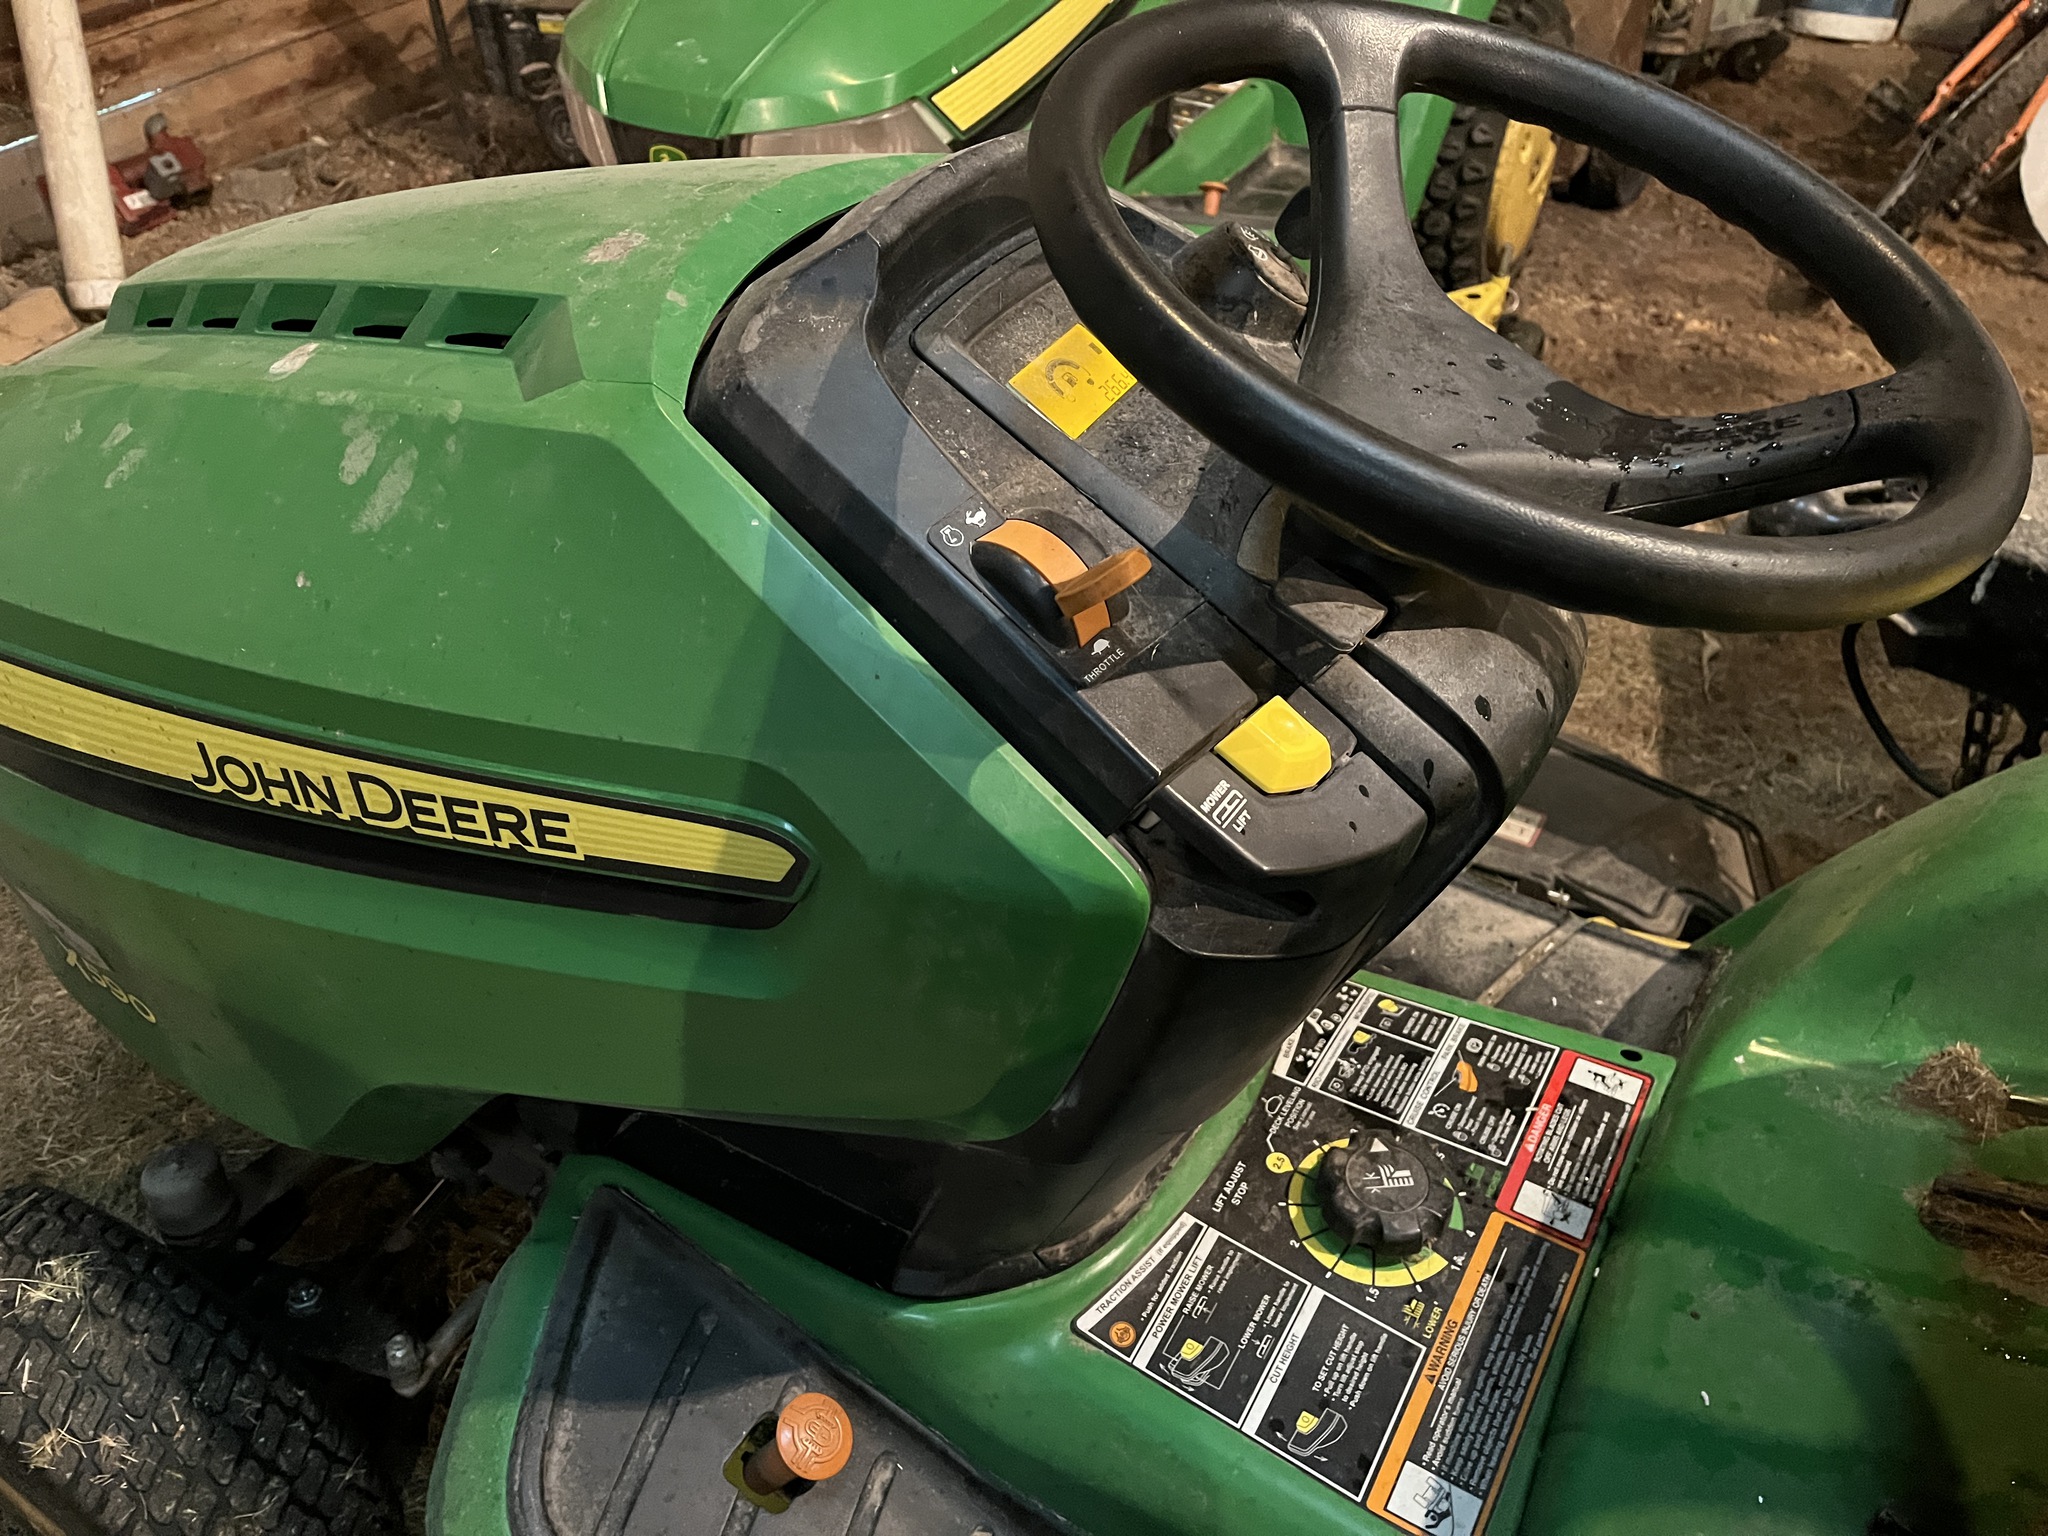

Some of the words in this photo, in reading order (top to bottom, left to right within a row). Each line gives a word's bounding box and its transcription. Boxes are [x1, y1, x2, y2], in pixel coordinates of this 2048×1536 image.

[1098, 369, 1134, 402] 266.4
[1083, 647, 1125, 683] THROTTLE
[191, 741, 344, 815] JOHN
[347, 771, 578, 854] DEERE
[1200, 779, 1231, 814] MOWER
[1232, 809, 1251, 833] LIFT
[1269, 1115, 1284, 1134] DECK
[1280, 1086, 1301, 1116] LEVELING
[1284, 1099, 1305, 1127] POSITION
[1407, 1101, 1423, 1125] CRUISE
[1420, 1072, 1440, 1099] CONTROL
[1528, 1104, 1551, 1143] DANGER
[1273, 1156, 1285, 1170] 2.5
[1213, 1193, 1227, 1212] LIFT
[1223, 1161, 1246, 1194] ADJUST
[1231, 1182, 1248, 1205] STOP
[1290, 1240, 1300, 1248] 2
[1465, 1229, 1476, 1238] 4
[1096, 1279, 1132, 1313] TRACTION
[1131, 1256, 1155, 1281] ASSIST
[1152, 1307, 1174, 1338] POWER
[1170, 1274, 1192, 1306] MOWER
[1188, 1255, 1202, 1273] LIFT
[1182, 1291, 1199, 1314] RAISE
[1195, 1265, 1214, 1291] MOWER
[1365, 1285, 1381, 1303] 1.5
[1141, 1302, 1154, 1318] Push
[1151, 1292, 1159, 1302] for
[1238, 1321, 1256, 1349] LOWER
[1253, 1295, 1270, 1321] MOWER
[1422, 1307, 1443, 1339] LOWER
[1428, 1319, 1458, 1371] WARNING
[1438, 1367, 1452, 1391] AVOID
[1447, 1335, 1467, 1367] SERIOUS
[1461, 1308, 1476, 1335] INJURY
[1472, 1297, 1482, 1308] OR
[1477, 1274, 1491, 1297] DEATH
[1269, 1365, 1283, 1383] CUT
[1279, 1333, 1299, 1365] HEIGHT
[1312, 1381, 1322, 1391] TO
[1318, 1365, 1329, 1381] SET
[1325, 1350, 1336, 1366] CUT
[1332, 1324, 1349, 1351] HEIGHT
[1324, 1380, 1335, 1394] Pull
[1332, 1371, 1339, 1380] up
[1336, 1362, 1344, 1371] on
[1332, 1383, 1344, 1397] Turn
[1349, 1390, 1362, 1407] Push
[1358, 1372, 1370, 1390] down
[1367, 1363, 1374, 1372] on
[1422, 1441, 1436, 1462] Read
[1432, 1405, 1451, 1441] operator's
[1432, 1444, 1446, 1467] Avoid
